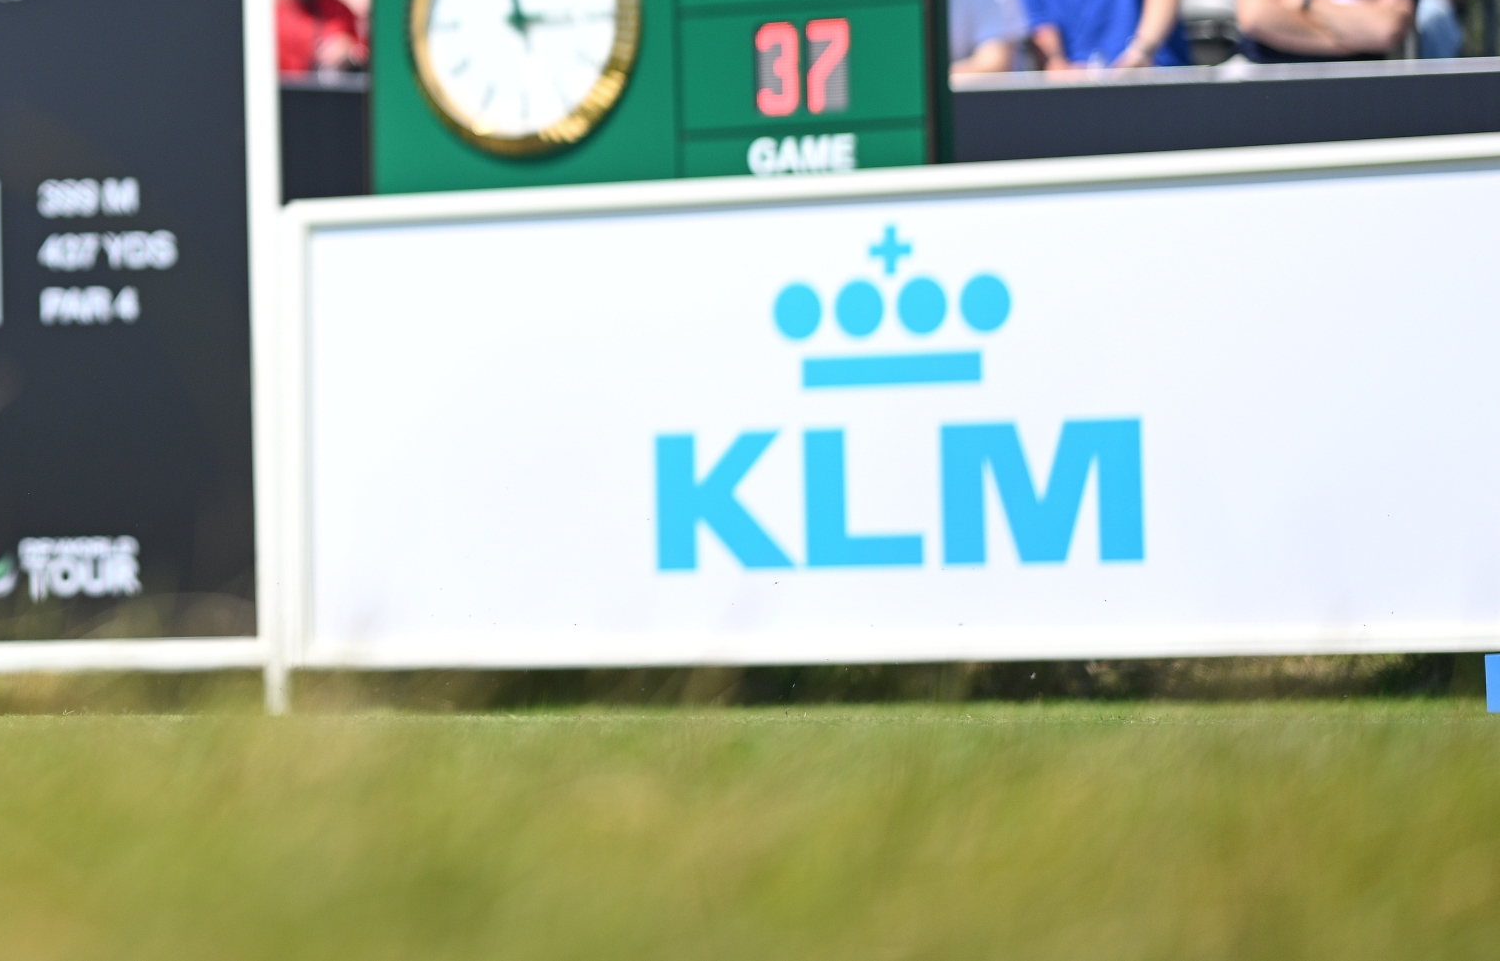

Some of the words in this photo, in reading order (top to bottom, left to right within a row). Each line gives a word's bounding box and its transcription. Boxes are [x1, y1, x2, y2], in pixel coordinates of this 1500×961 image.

[755, 17, 851, 117] 37
[747, 132, 857, 176] GAME
[100, 176, 141, 217] M
[101, 229, 179, 271] YDS
[39, 285, 113, 326] PAR
[112, 285, 141, 325] 4
[653, 417, 1147, 573] KLM
[21, 555, 143, 602] TOUR
